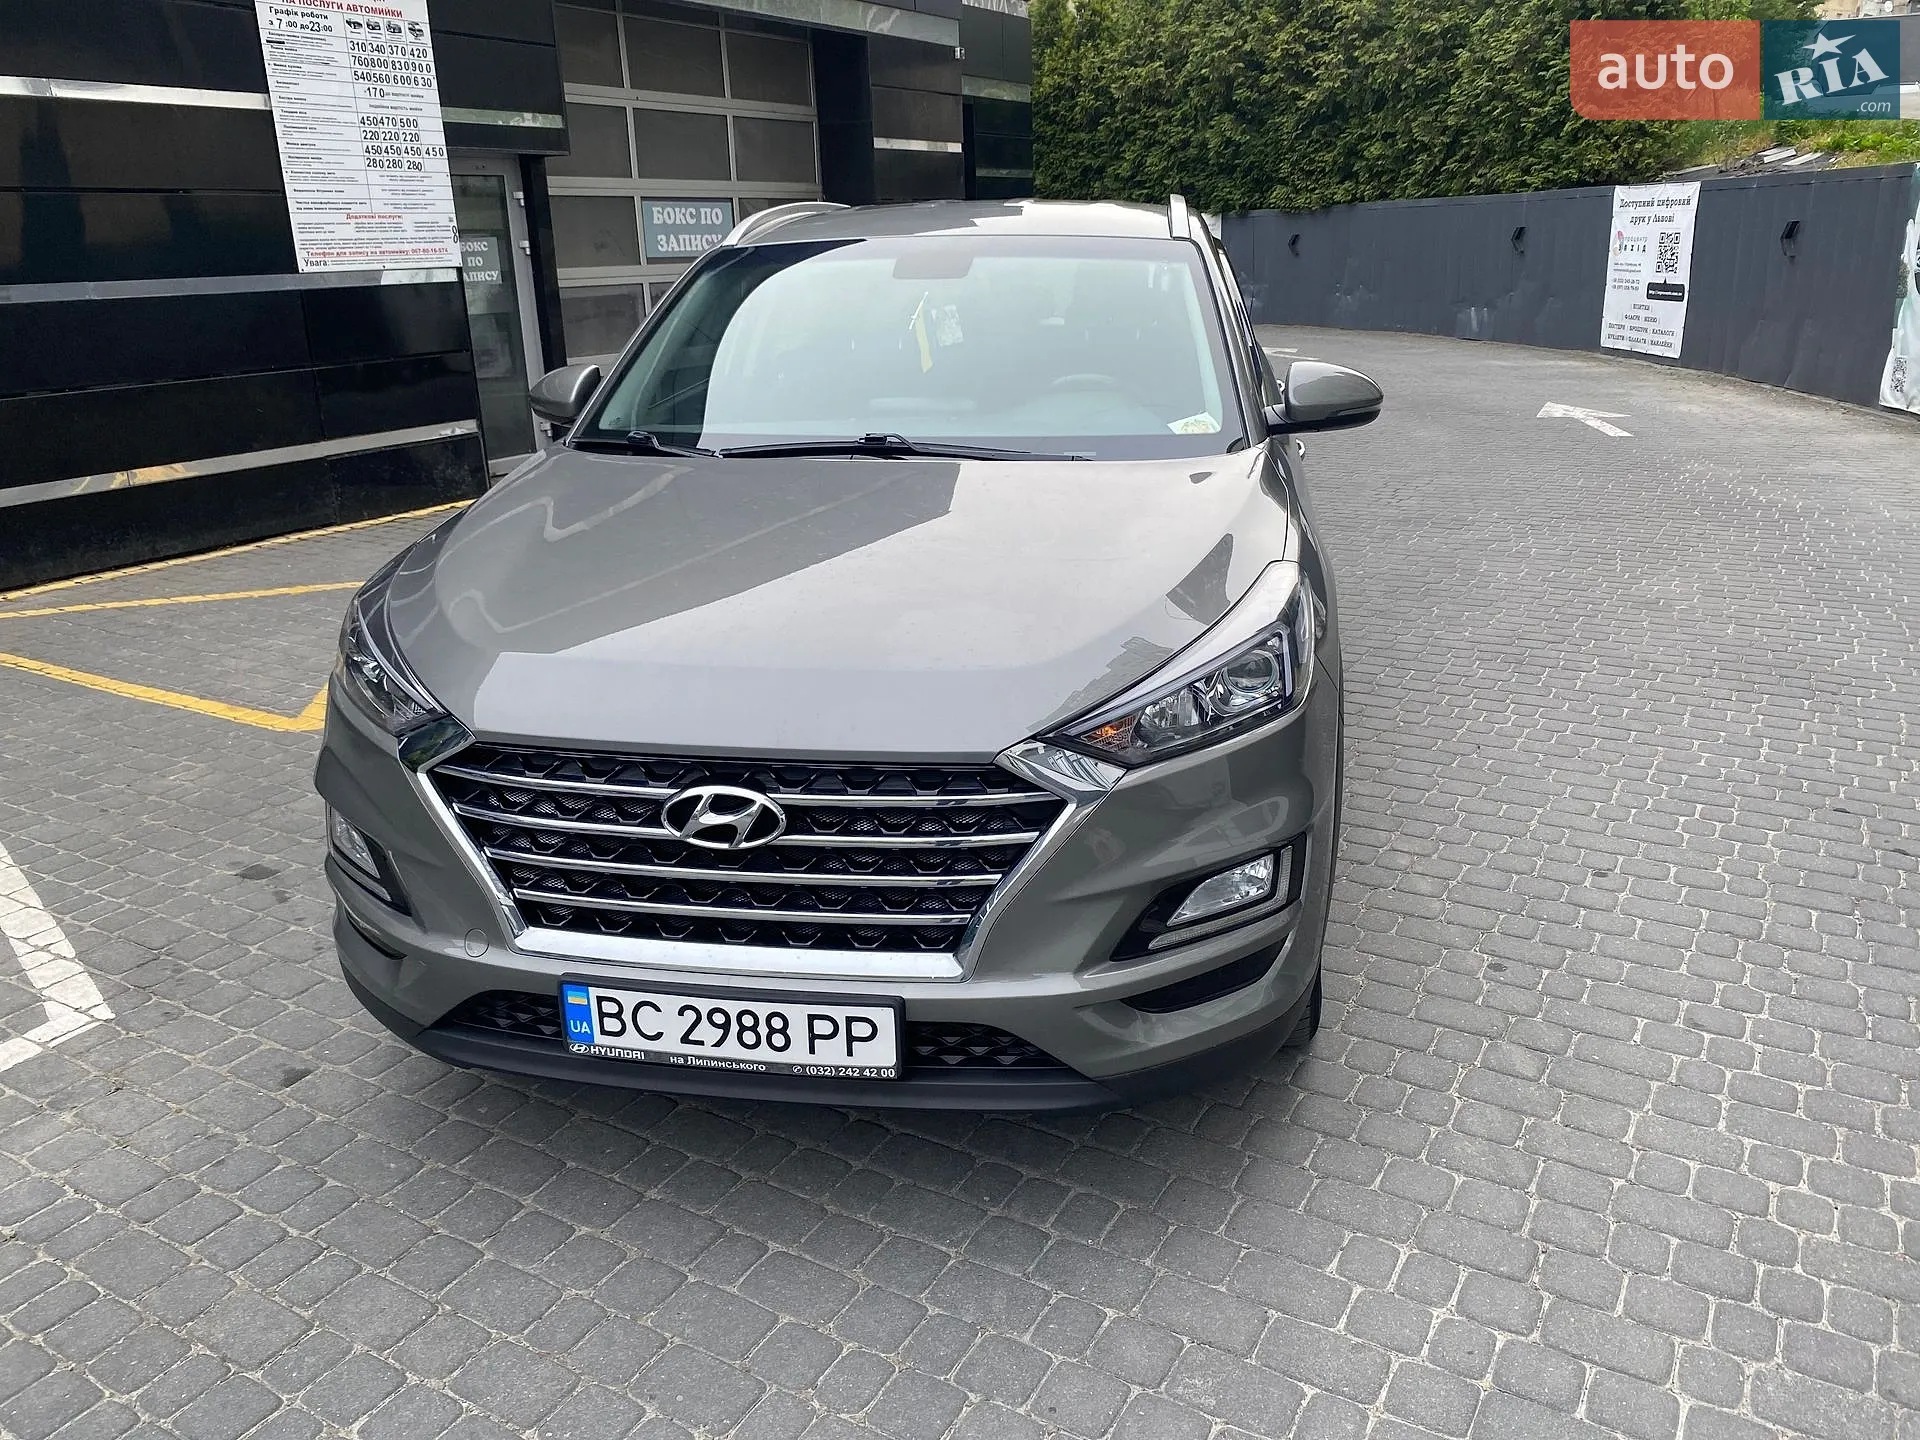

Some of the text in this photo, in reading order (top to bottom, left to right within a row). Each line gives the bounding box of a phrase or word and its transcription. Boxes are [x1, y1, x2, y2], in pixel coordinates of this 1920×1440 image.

[268, 6, 328, 20] Графік роботи
[346, 3, 403, 18] АВТОМИЙКИ
[350, 41, 428, 59] 310 340 370 420
[351, 55, 370, 68] 760
[370, 57, 389, 70] 800
[391, 59, 410, 71] 830
[410, 60, 432, 73] 900
[353, 71, 433, 88] 540 560 600 630
[359, 116, 378, 127] 450
[379, 117, 397, 128] 470
[399, 117, 418, 129] 500
[362, 130, 420, 142] 220 220 220
[365, 144, 444, 157] 450 450 450 450
[366, 158, 422, 172] 280 280 280
[1620, 196, 1691, 209] Доступний цифровий
[652, 206, 723, 225] БОКС ПО
[1630, 216, 1647, 225] друк
[1652, 213, 1675, 223] Львові
[306, 250, 334, 258] Телефон
[303, 258, 330, 267] Увага:
[468, 257, 483, 266] ПО
[463, 270, 499, 281] АПИСУ
[570, 1019, 592, 1035] UA
[595, 995, 880, 1058] BC 2988 PP
[590, 1046, 645, 1060] HYUNDAI
[670, 1055, 767, 1072] на Липинського
[805, 1065, 896, 1079] (032) 242 42 00
